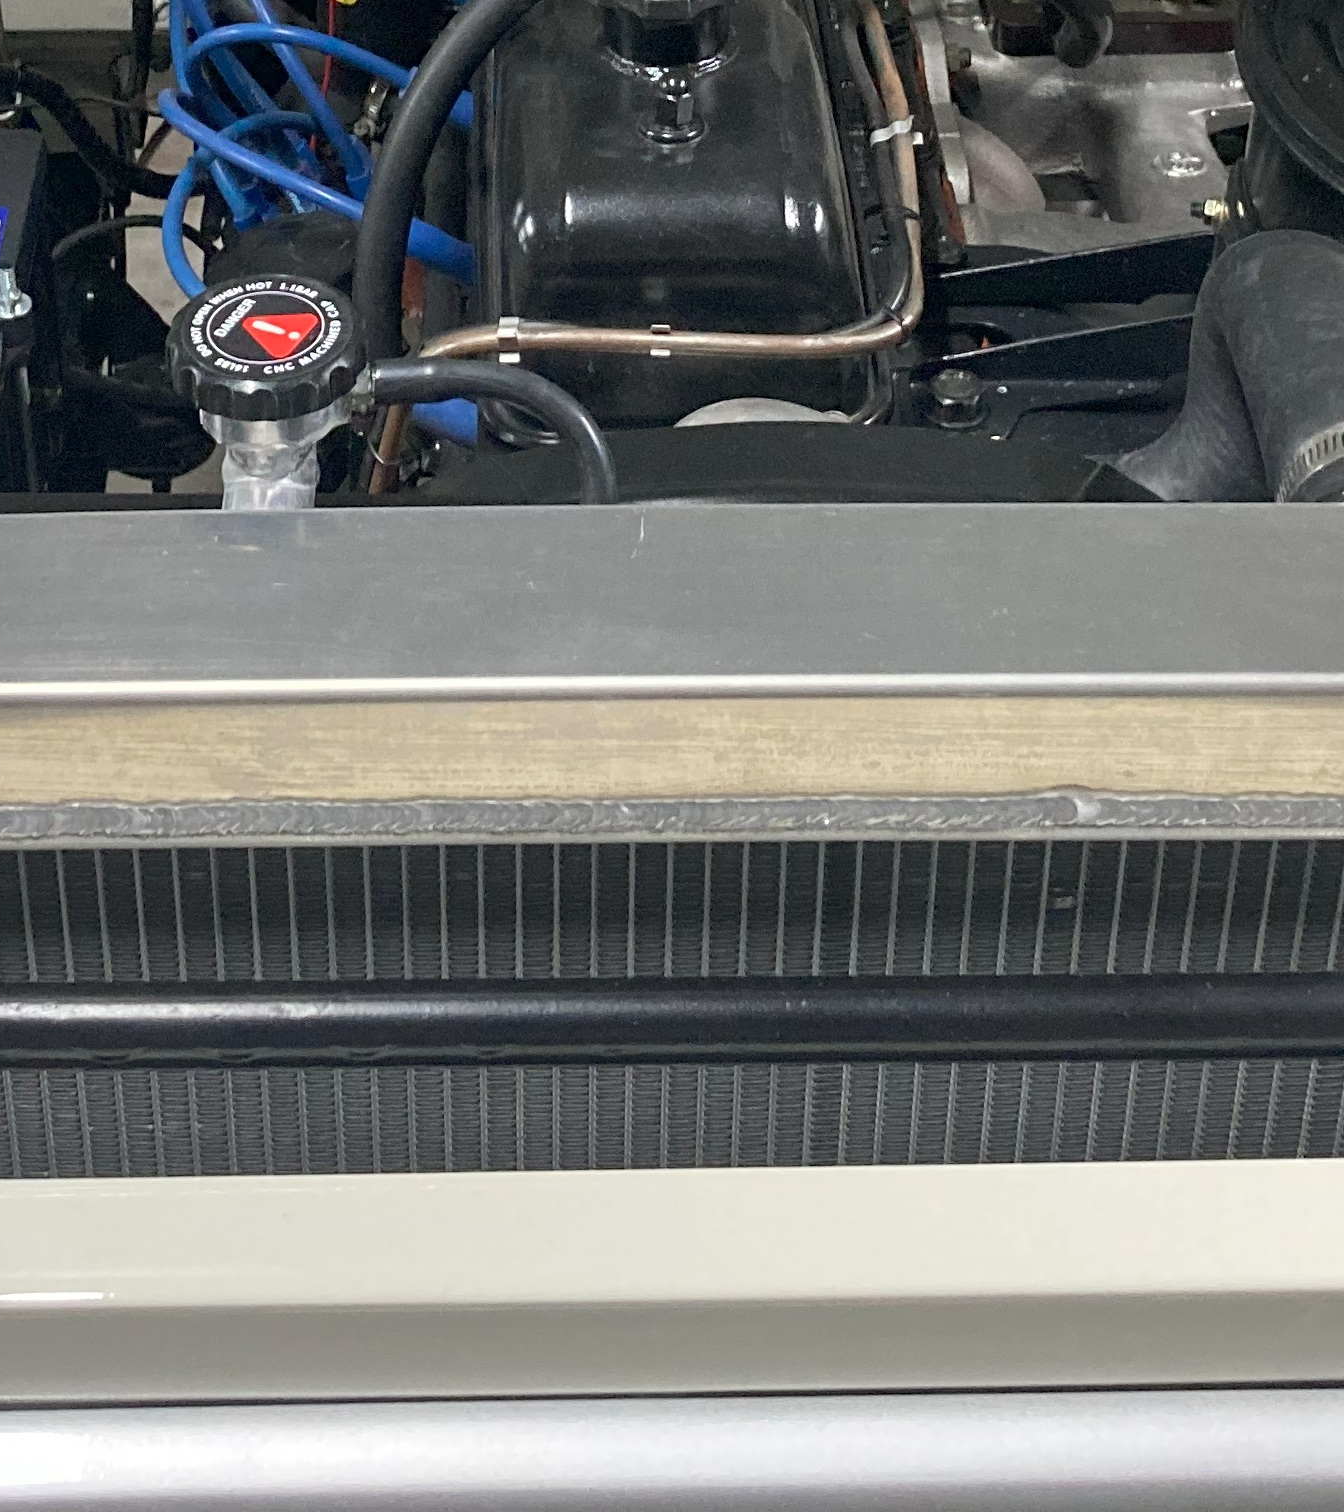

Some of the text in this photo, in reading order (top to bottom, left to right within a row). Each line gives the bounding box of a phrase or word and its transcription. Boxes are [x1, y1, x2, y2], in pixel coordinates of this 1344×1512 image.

[209, 286, 244, 305] WHEN
[245, 281, 273, 291] HOT
[192, 304, 213, 325] OPEN
[213, 298, 257, 338] DANGER
[190, 327, 203, 345] NOT
[263, 300, 342, 375] CNC MACHINED CAP
[196, 344, 213, 357] DO
